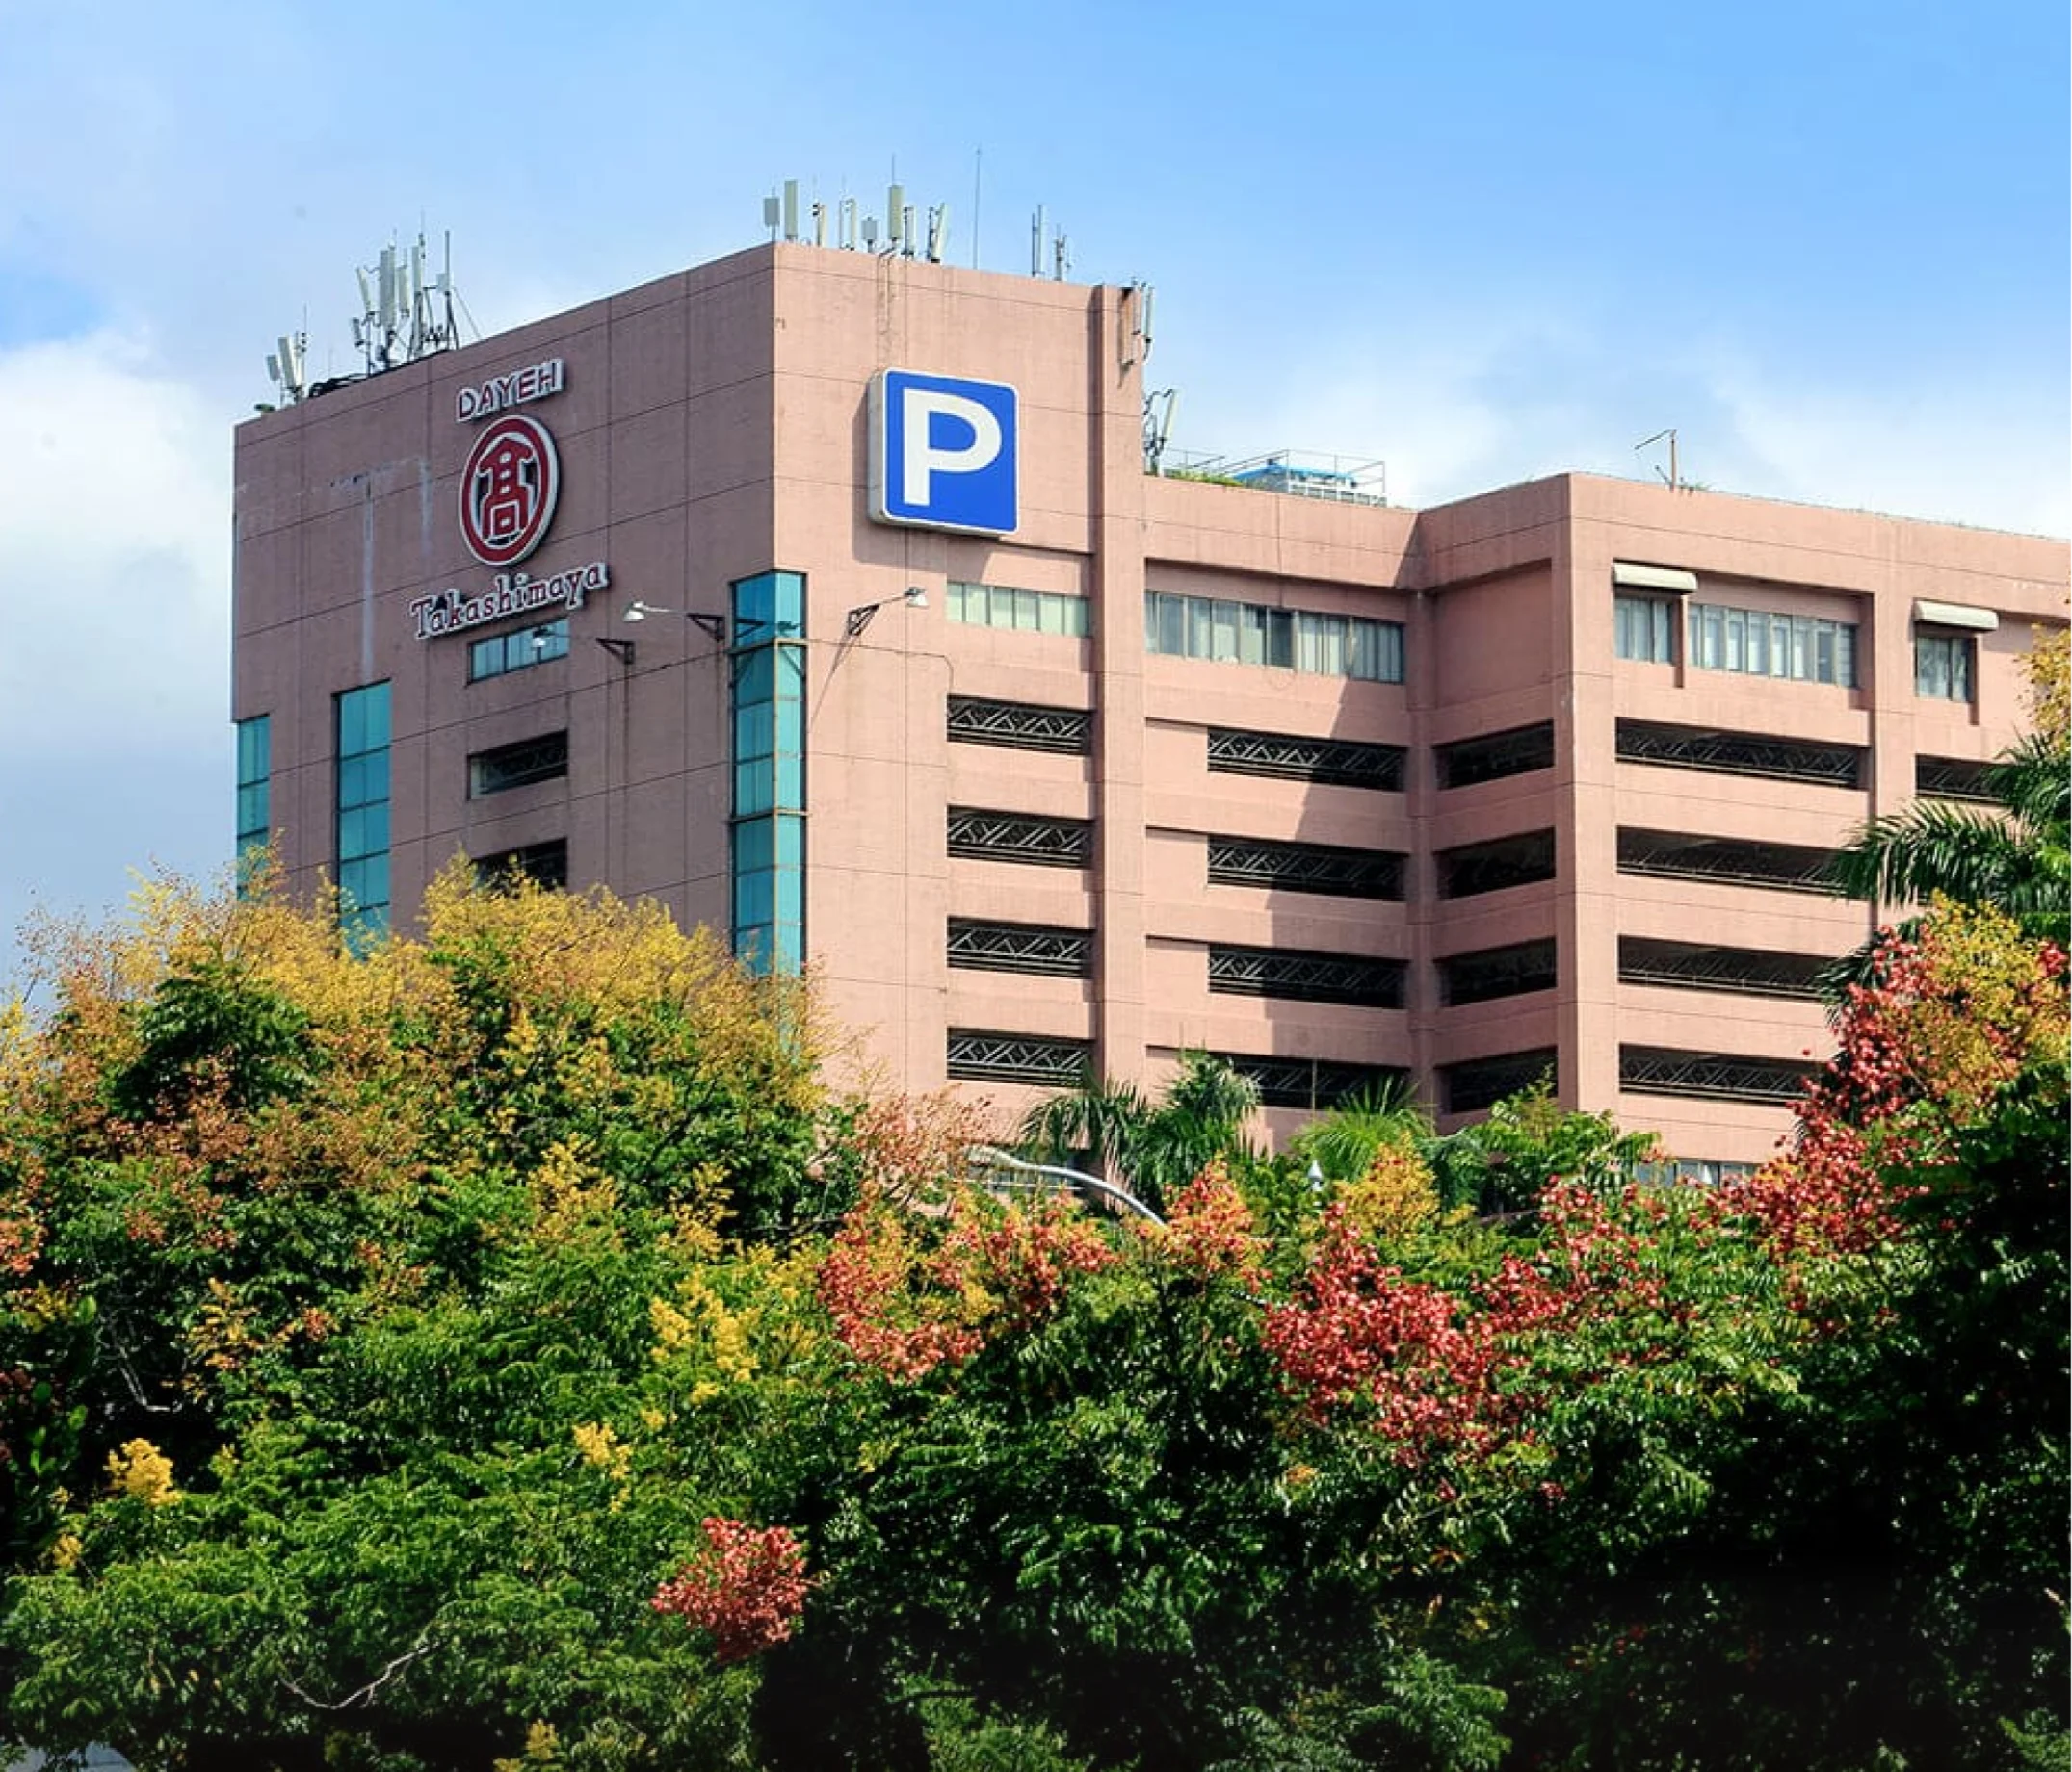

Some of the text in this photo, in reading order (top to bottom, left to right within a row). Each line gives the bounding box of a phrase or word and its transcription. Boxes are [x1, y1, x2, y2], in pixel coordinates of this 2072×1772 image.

[457, 358, 564, 422] DAYEH
[903, 387, 1003, 506] P
[410, 562, 611, 640] Takashimaya
